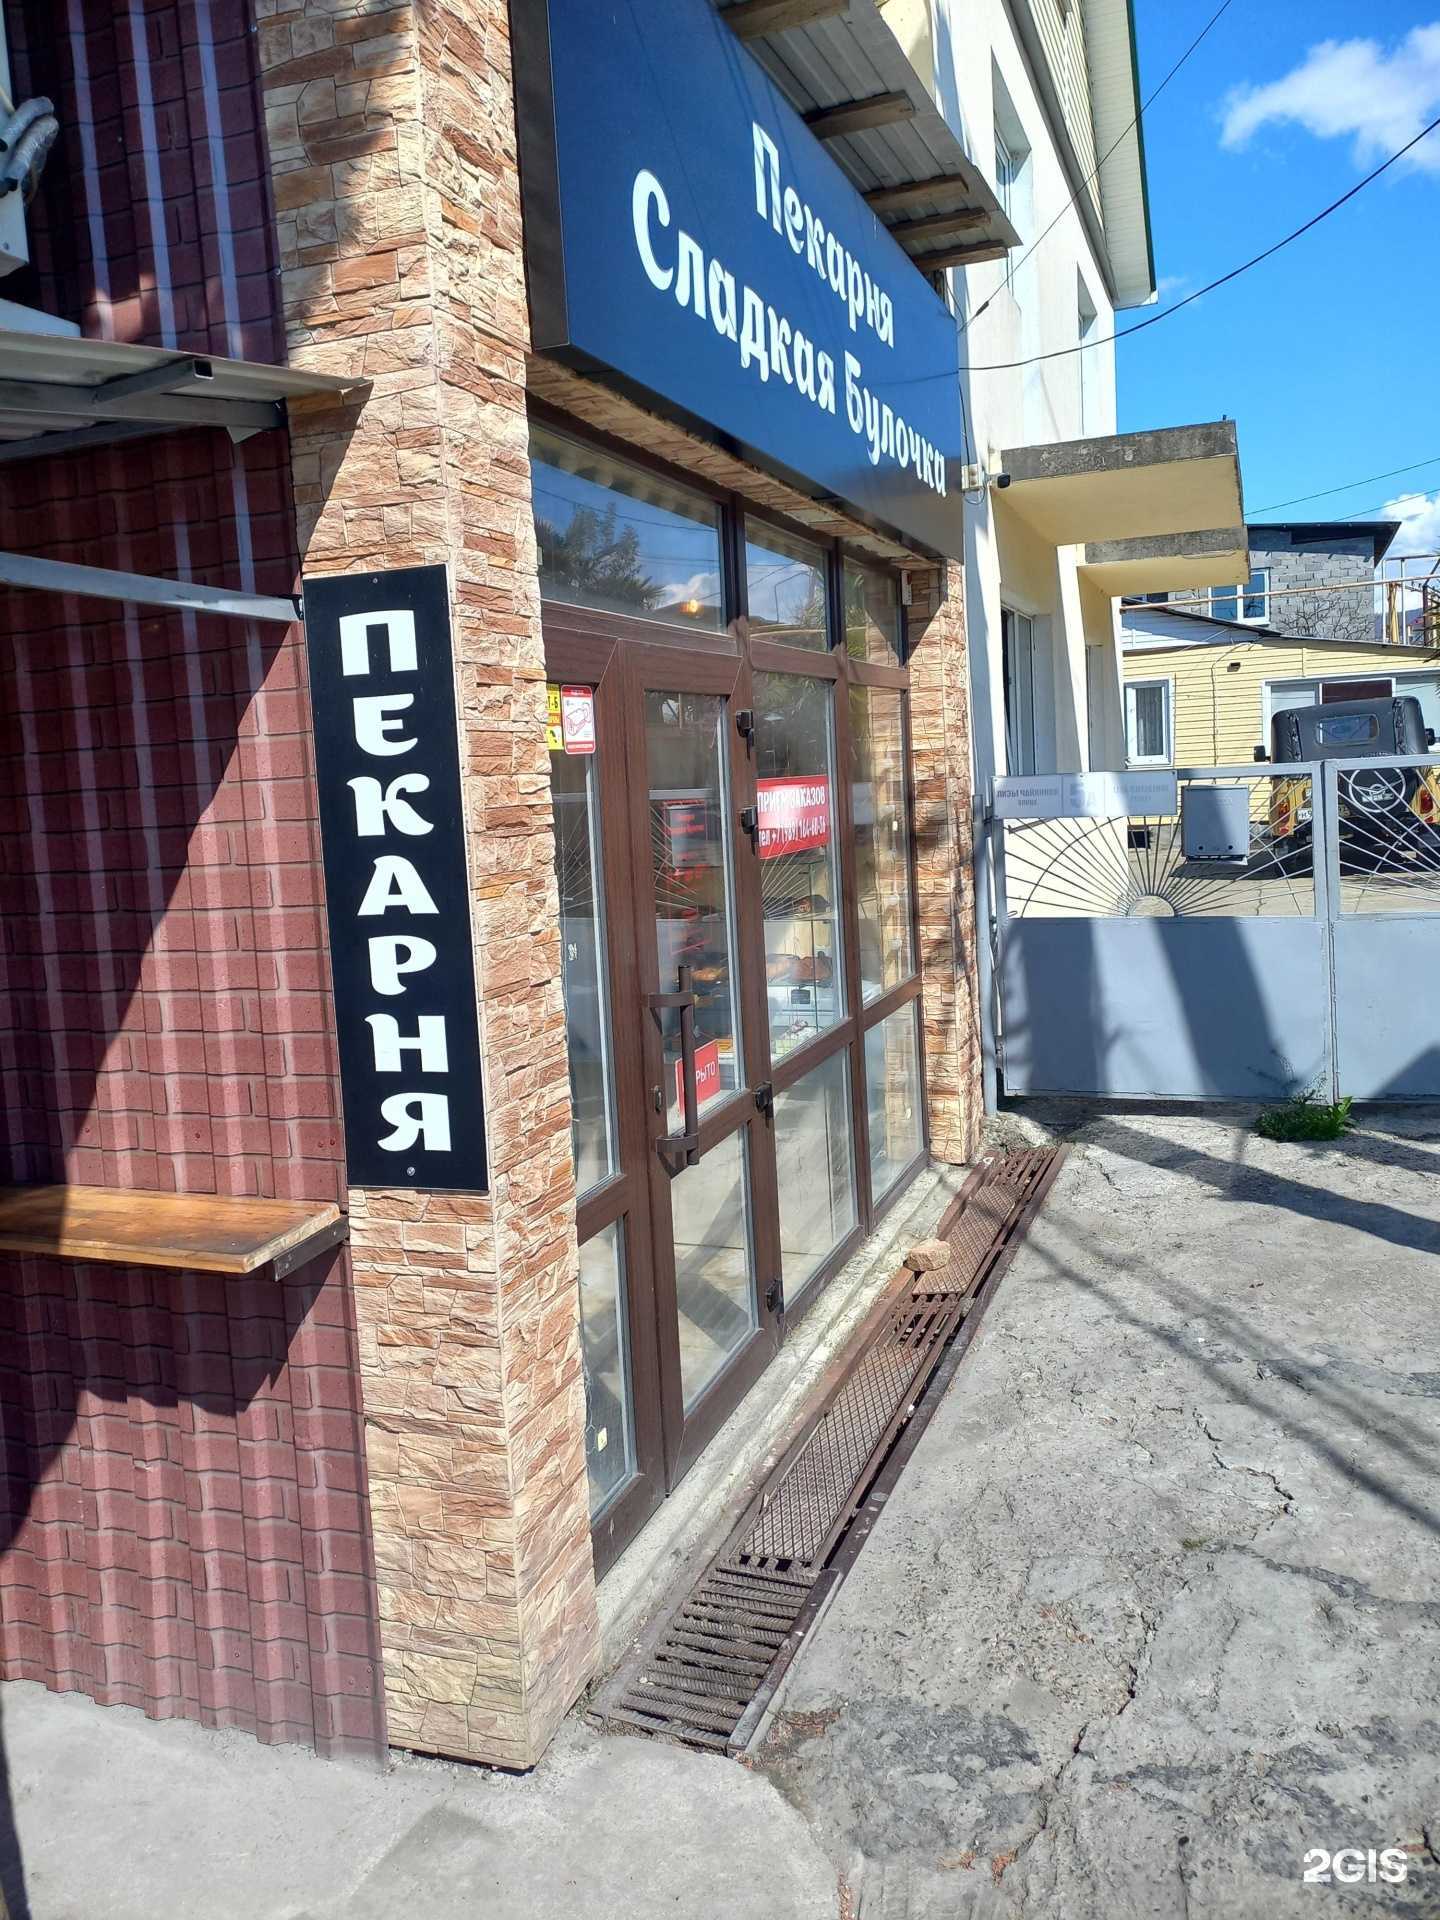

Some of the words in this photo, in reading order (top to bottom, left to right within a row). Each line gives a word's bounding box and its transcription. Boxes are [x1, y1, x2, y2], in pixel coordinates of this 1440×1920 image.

[632, 169, 836, 415] Сладкая
[844, 350, 947, 498] Булочка
[752, 121, 894, 348] Пекарня
[338, 609, 452, 1152] ПЕКАРНЯ
[789, 785, 826, 809] ЗАКАЗОВ
